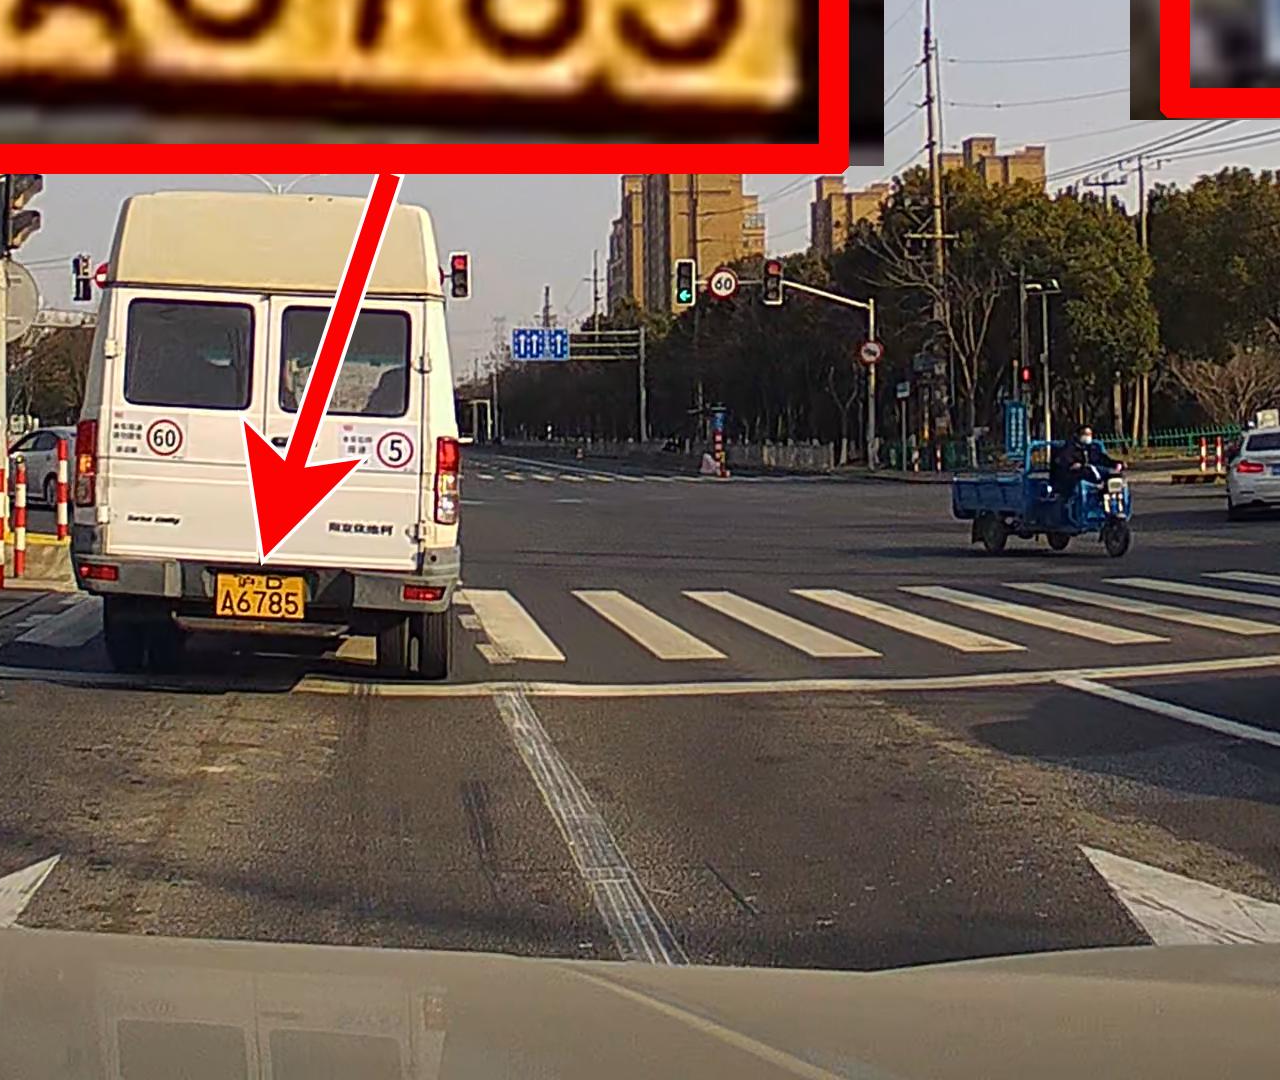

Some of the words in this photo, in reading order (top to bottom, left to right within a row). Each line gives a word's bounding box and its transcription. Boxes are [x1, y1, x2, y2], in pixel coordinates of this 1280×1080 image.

[714, 276, 733, 291] 60
[153, 428, 176, 447] 60
[388, 439, 403, 462] 5
[221, 589, 299, 615] A6785
